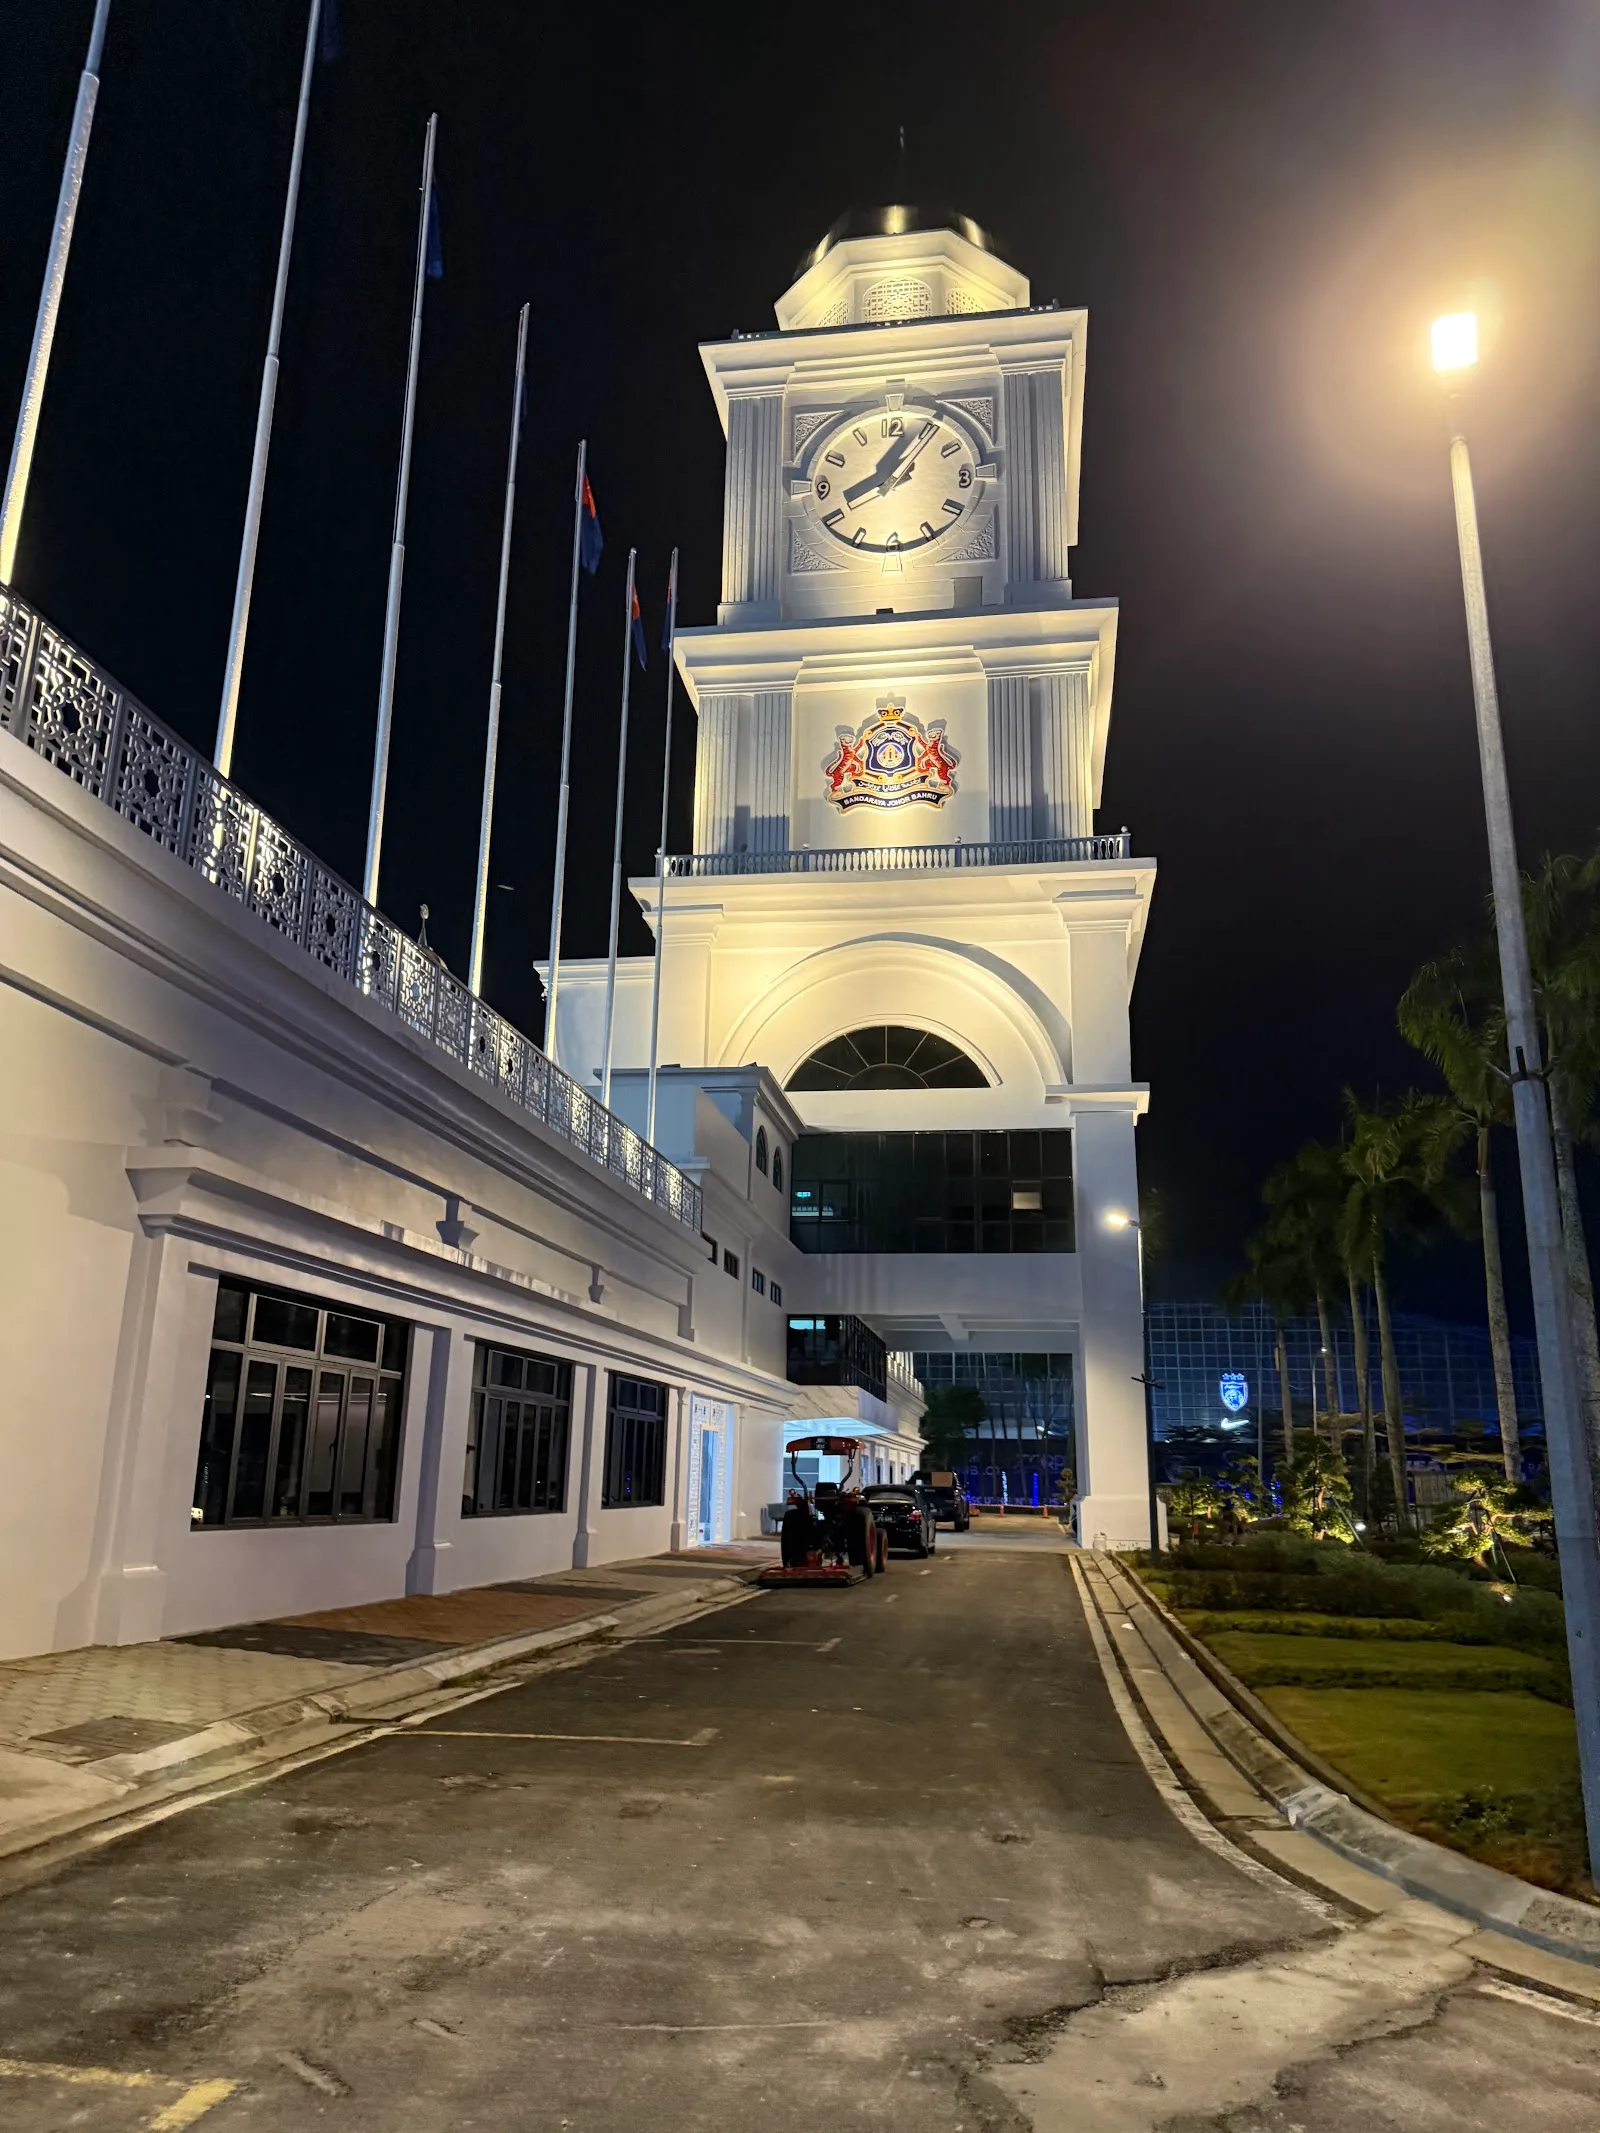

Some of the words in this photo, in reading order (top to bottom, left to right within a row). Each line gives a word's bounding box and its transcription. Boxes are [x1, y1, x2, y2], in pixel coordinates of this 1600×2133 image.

[881, 417, 904, 437] 12
[958, 469, 972, 489] 3
[816, 481, 831, 500] 9
[885, 531, 901, 551] 6
[844, 796, 886, 806] BANDARAYA
[887, 796, 911, 806] JOHOR
[911, 792, 937, 800] BAHRU
